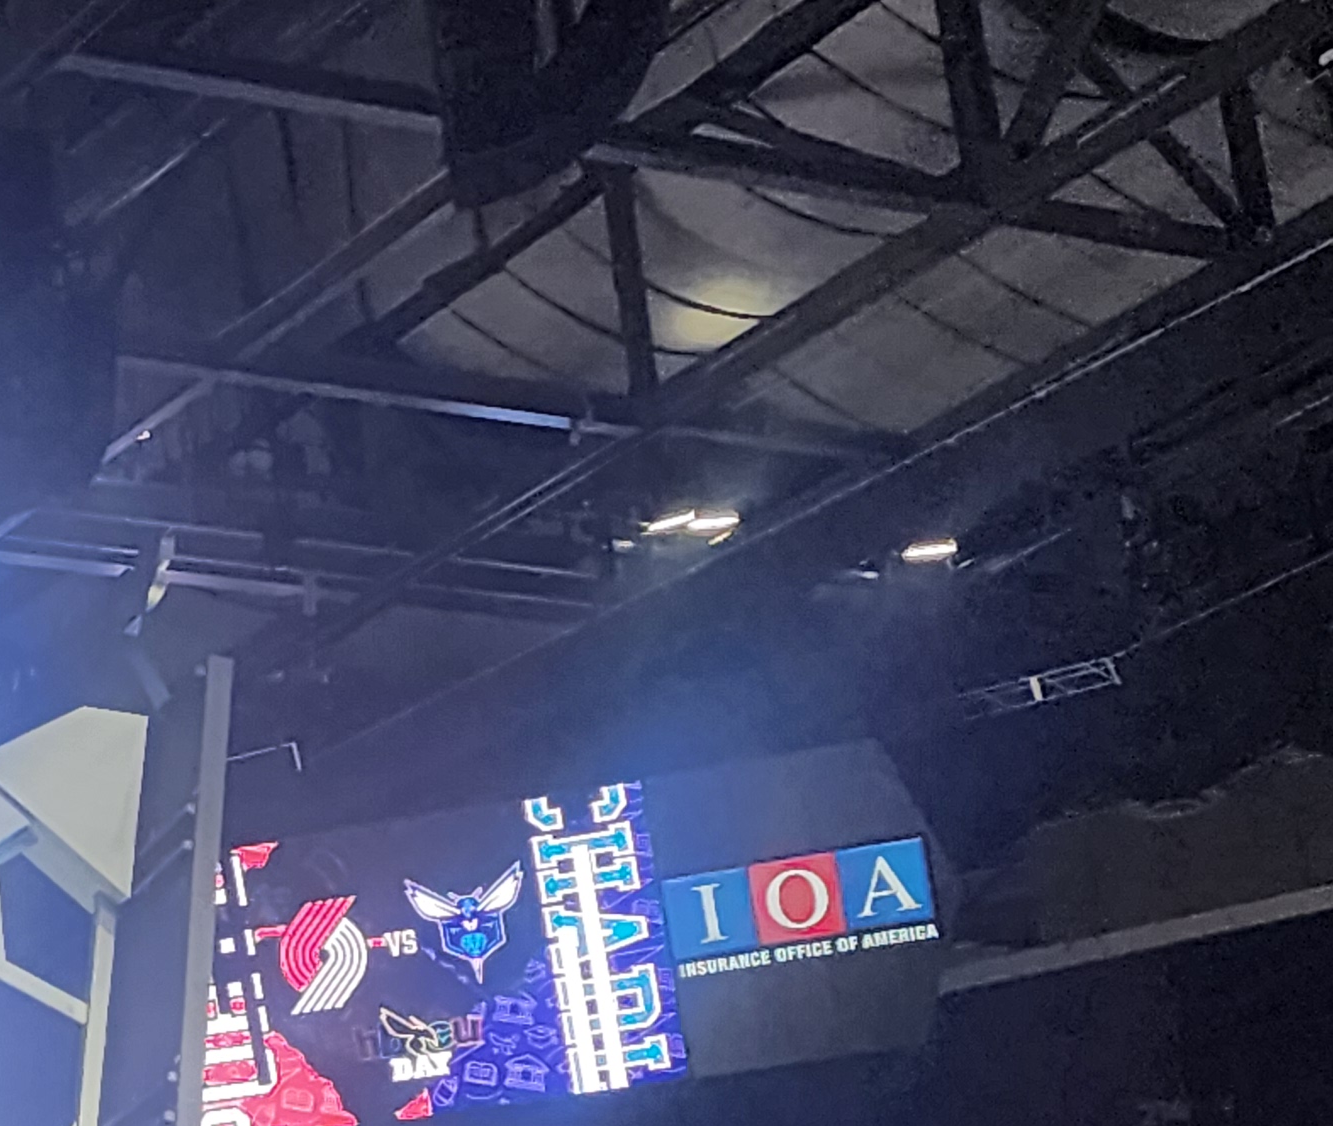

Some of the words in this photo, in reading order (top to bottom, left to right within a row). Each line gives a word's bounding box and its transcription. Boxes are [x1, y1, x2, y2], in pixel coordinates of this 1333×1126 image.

[691, 855, 923, 944] IOA
[383, 929, 419, 957] VS
[678, 956, 771, 979] INSURANCE
[773, 940, 834, 965] OFFICE
[836, 934, 859, 953] OF
[861, 923, 940, 950] AMERICA
[389, 1051, 453, 1082] DAY
